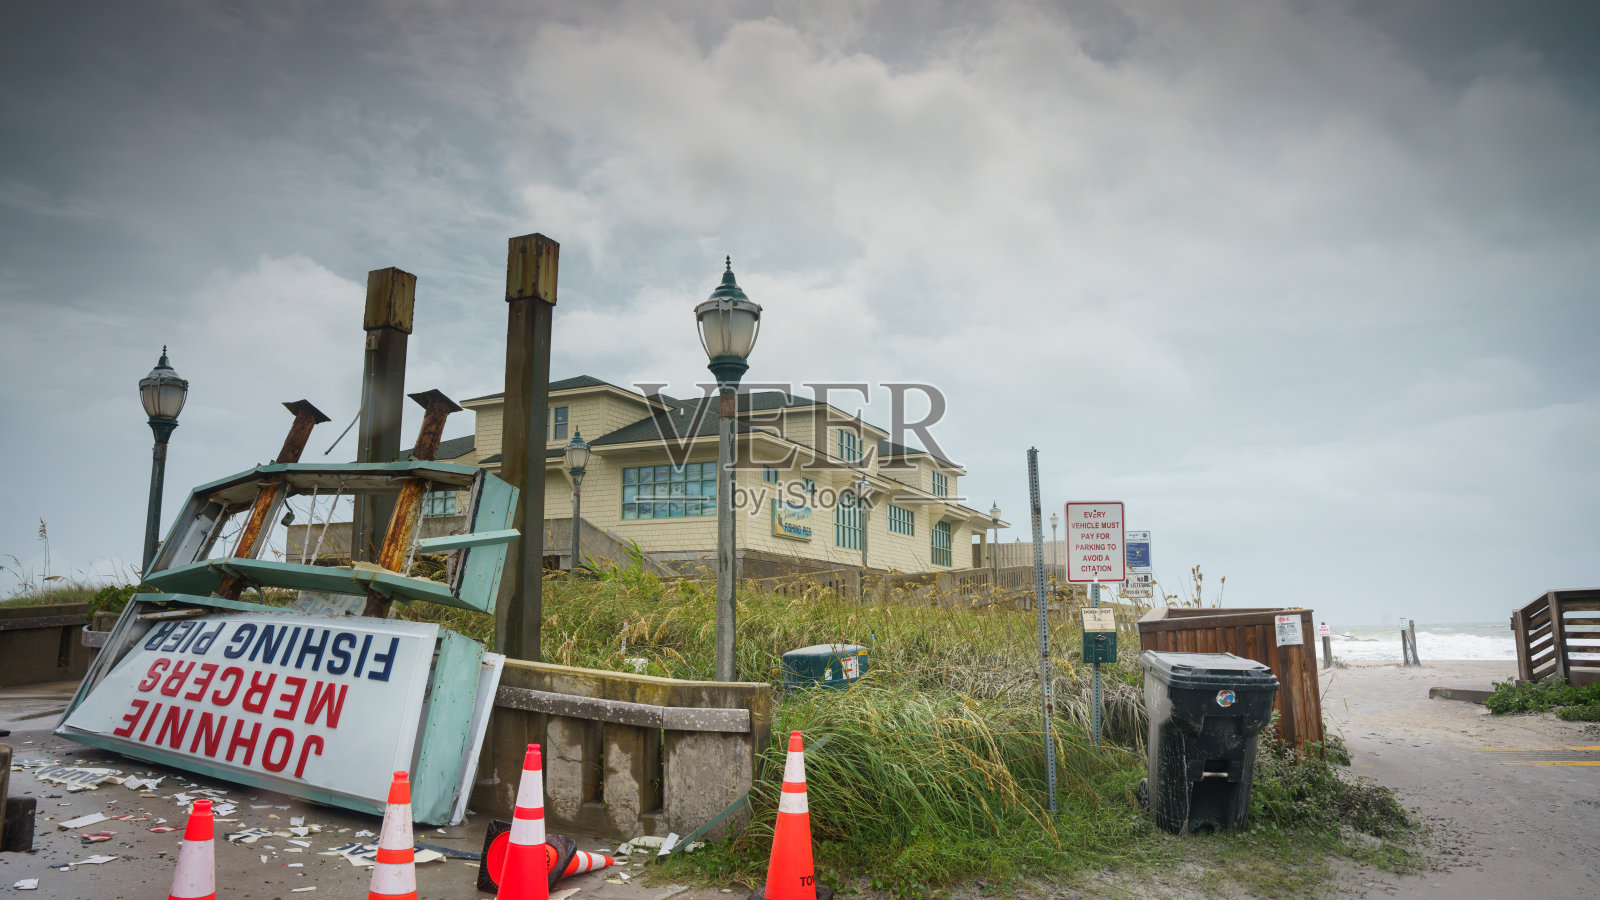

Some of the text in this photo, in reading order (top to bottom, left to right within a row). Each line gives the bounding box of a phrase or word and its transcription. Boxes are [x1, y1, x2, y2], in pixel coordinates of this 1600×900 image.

[144, 621, 401, 683] FISHING PIER
[138, 657, 349, 729] MERCERS
[112, 698, 325, 779] JOHNNIE
